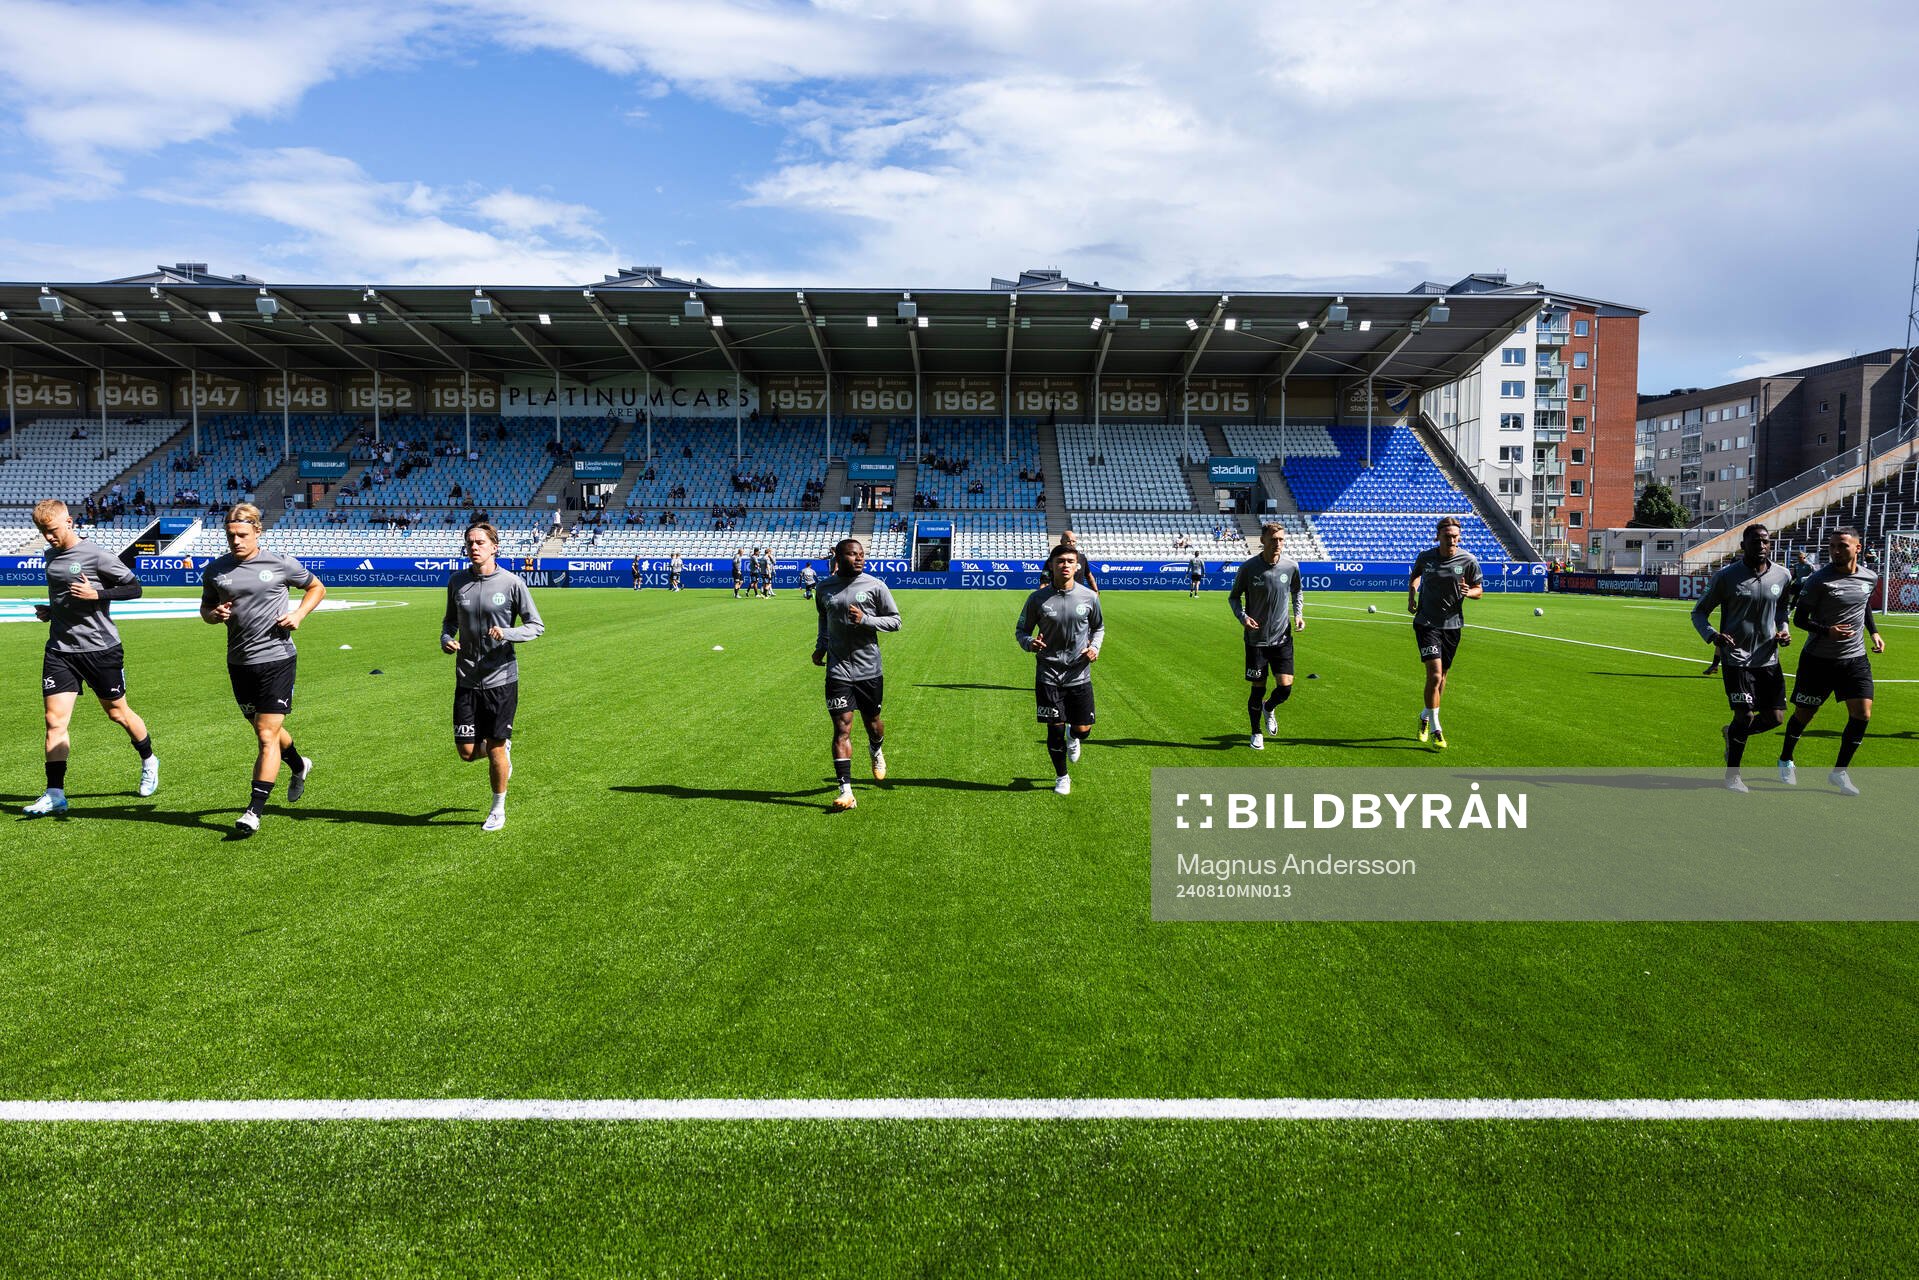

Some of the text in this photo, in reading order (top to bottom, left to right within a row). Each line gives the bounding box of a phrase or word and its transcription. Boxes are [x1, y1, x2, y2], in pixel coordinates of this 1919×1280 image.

[2, 385, 73, 405] 1945
[93, 385, 159, 406] 1946
[179, 386, 241, 407] 1947
[263, 386, 328, 407] 1948
[348, 387, 413, 408] 1952
[432, 387, 496, 408] 1956
[509, 386, 750, 407] PLATINUMCARS
[767, 389, 828, 410] 1957
[849, 390, 913, 411] 1960
[932, 390, 996, 411] 1962
[1016, 391, 1079, 411] 1963
[1099, 392, 1161, 412] 1989
[1182, 391, 1250, 412] 2015
[1211, 464, 1255, 475] stadium
[140, 559, 184, 570] EXISO
[584, 560, 613, 571] FRONT
[1335, 563, 1364, 572] HUGO
[6, 573, 35, 581] EXISO
[338, 573, 367, 582] EXISO
[636, 572, 669, 585] EXIS
[961, 574, 1008, 587] EXISO
[1112, 577, 1140, 585] EXISO
[1299, 576, 1332, 588] XISO
[1390, 578, 1405, 587] IFK
